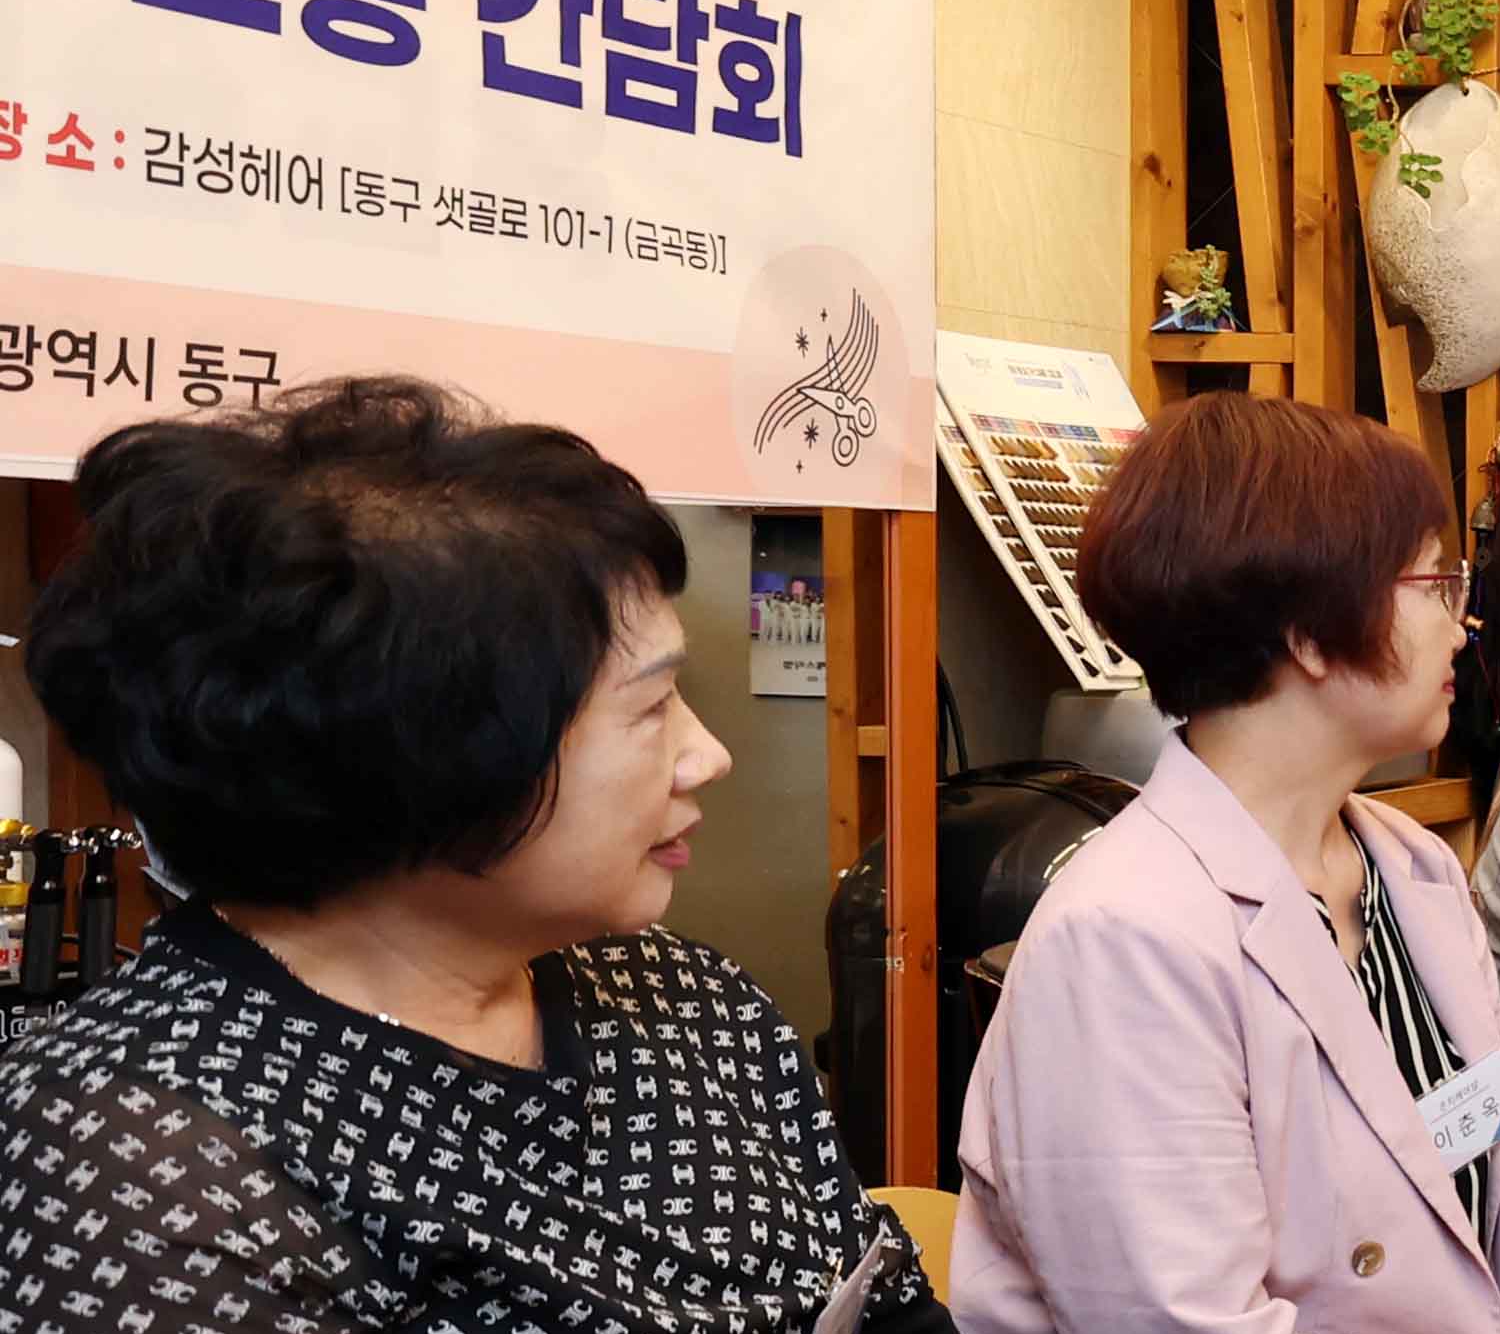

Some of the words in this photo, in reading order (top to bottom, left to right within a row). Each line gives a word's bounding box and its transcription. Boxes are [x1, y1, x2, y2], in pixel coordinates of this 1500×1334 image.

[144, 127, 324, 211] 감성헤어
[340, 166, 422, 223] [동구
[538, 203, 615, 255] 101-1
[624, 217, 727, 276] (금곡동)]
[178, 342, 281, 413] 동구
